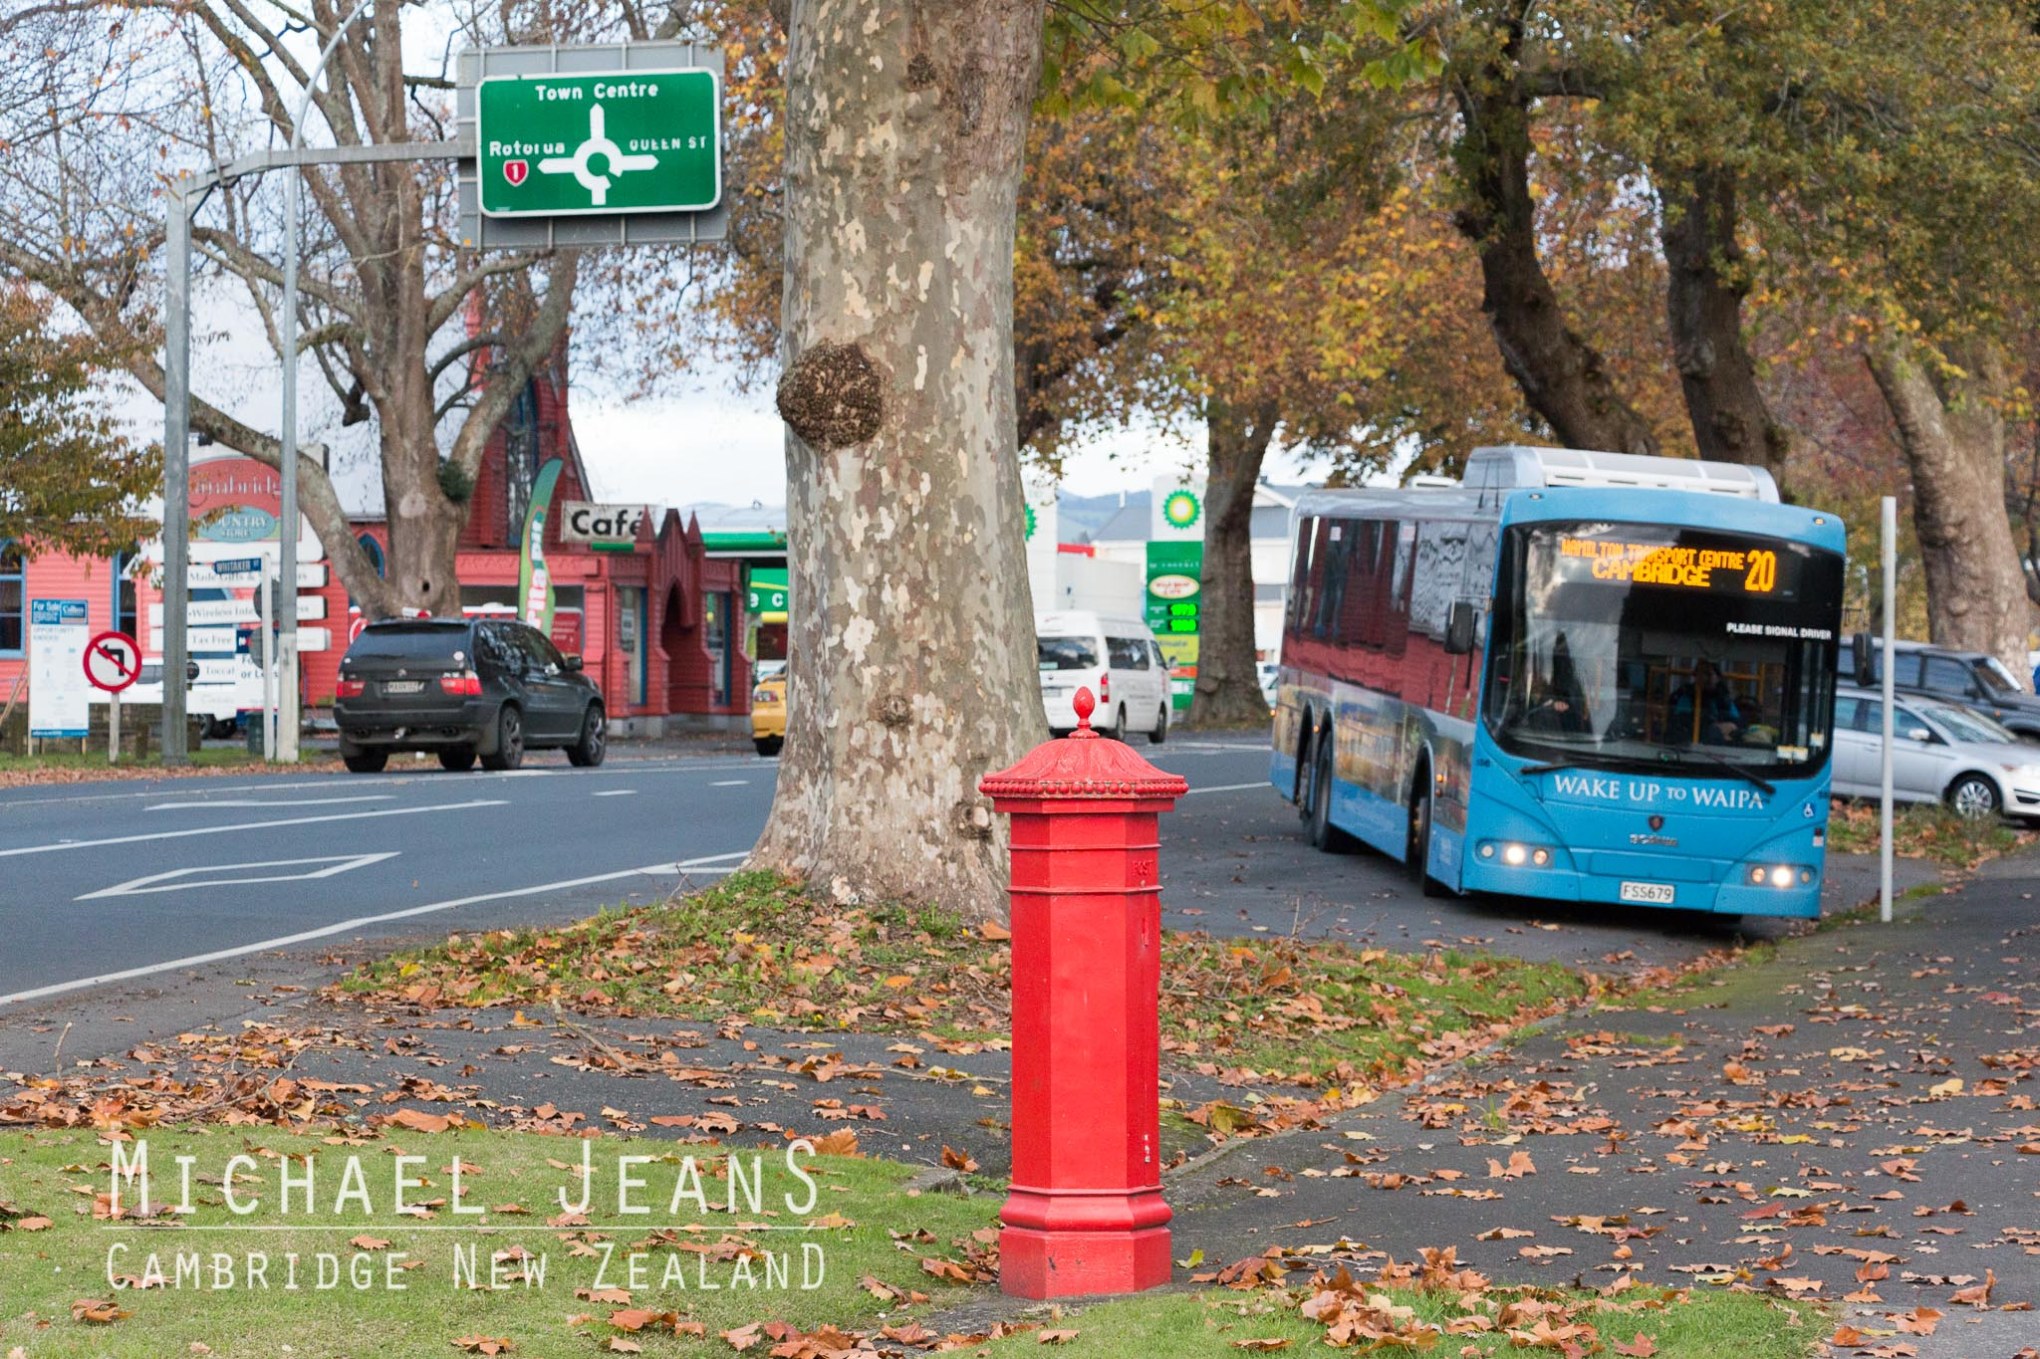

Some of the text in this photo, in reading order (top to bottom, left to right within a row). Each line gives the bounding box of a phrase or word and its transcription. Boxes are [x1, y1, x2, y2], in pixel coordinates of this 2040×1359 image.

[535, 82, 659, 101] Town Centre
[489, 140, 565, 157] Rotorua
[688, 136, 707, 149] ST
[510, 164, 519, 179] 1
[1699, 550, 1745, 570] CENTRE
[1591, 558, 1711, 587] CAMBRIDGE
[1745, 550, 1777, 592] 20
[1726, 622, 1833, 640] PLEASE SIGNAL DRIVER
[1554, 774, 1764, 810] WAKE UP TO WAIPA
[1623, 884, 1672, 901] FSS679
